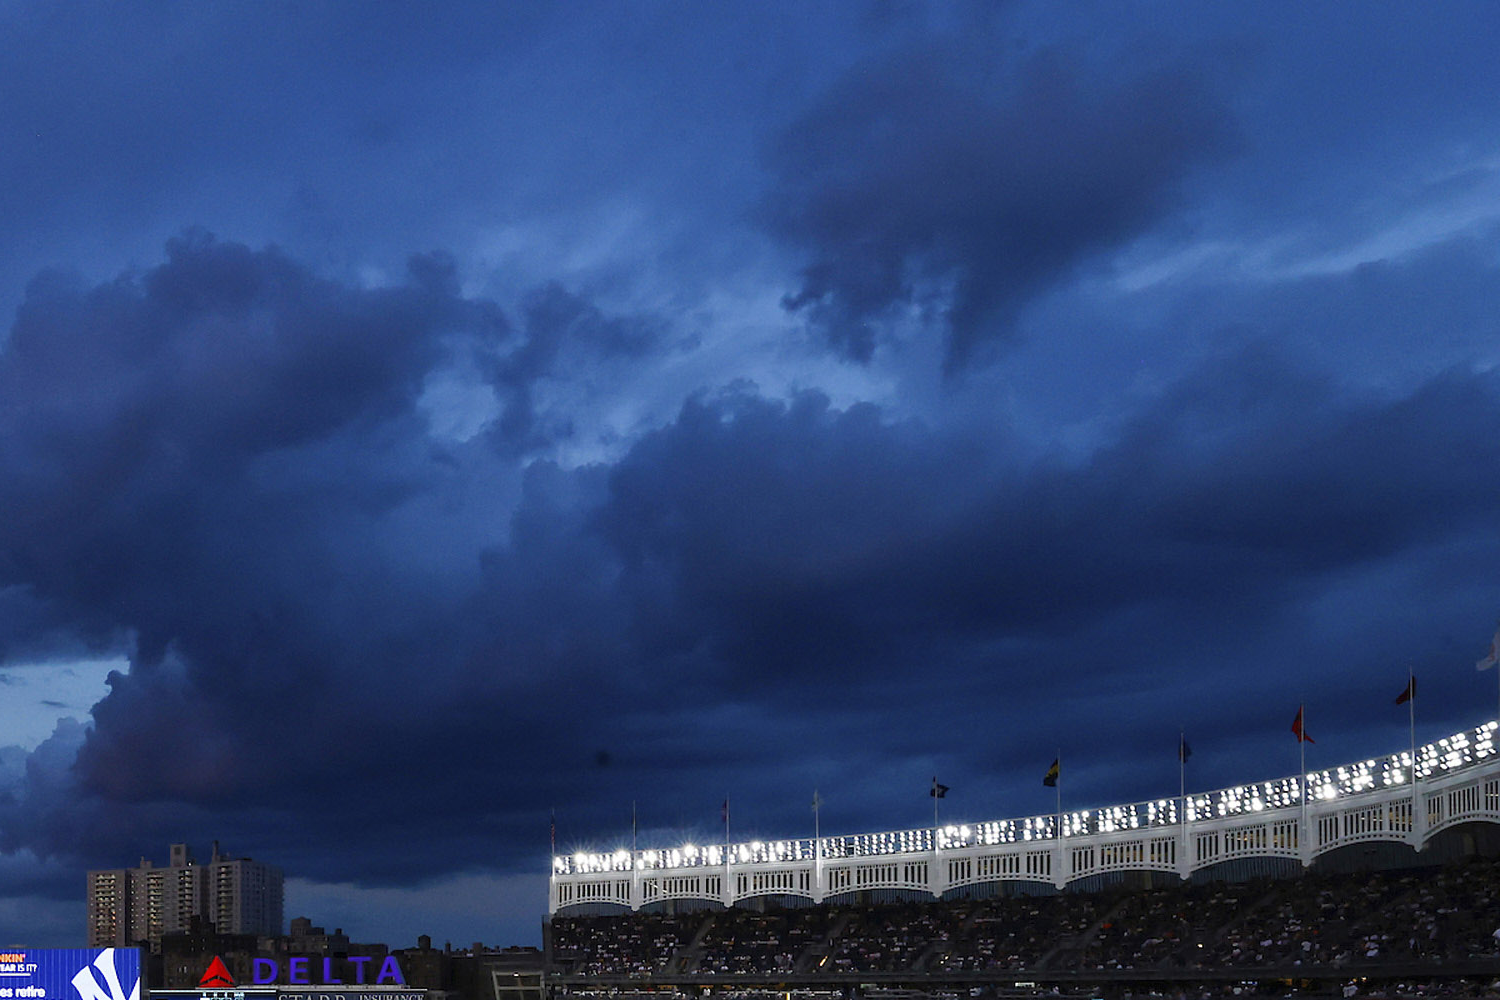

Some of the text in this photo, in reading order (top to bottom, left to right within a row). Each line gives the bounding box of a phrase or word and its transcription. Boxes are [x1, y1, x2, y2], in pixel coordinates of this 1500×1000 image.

[17, 964, 25, 972] IS
[26, 964, 38, 972] IT?
[252, 955, 404, 985] DELTA
[15, 985, 46, 998] retire
